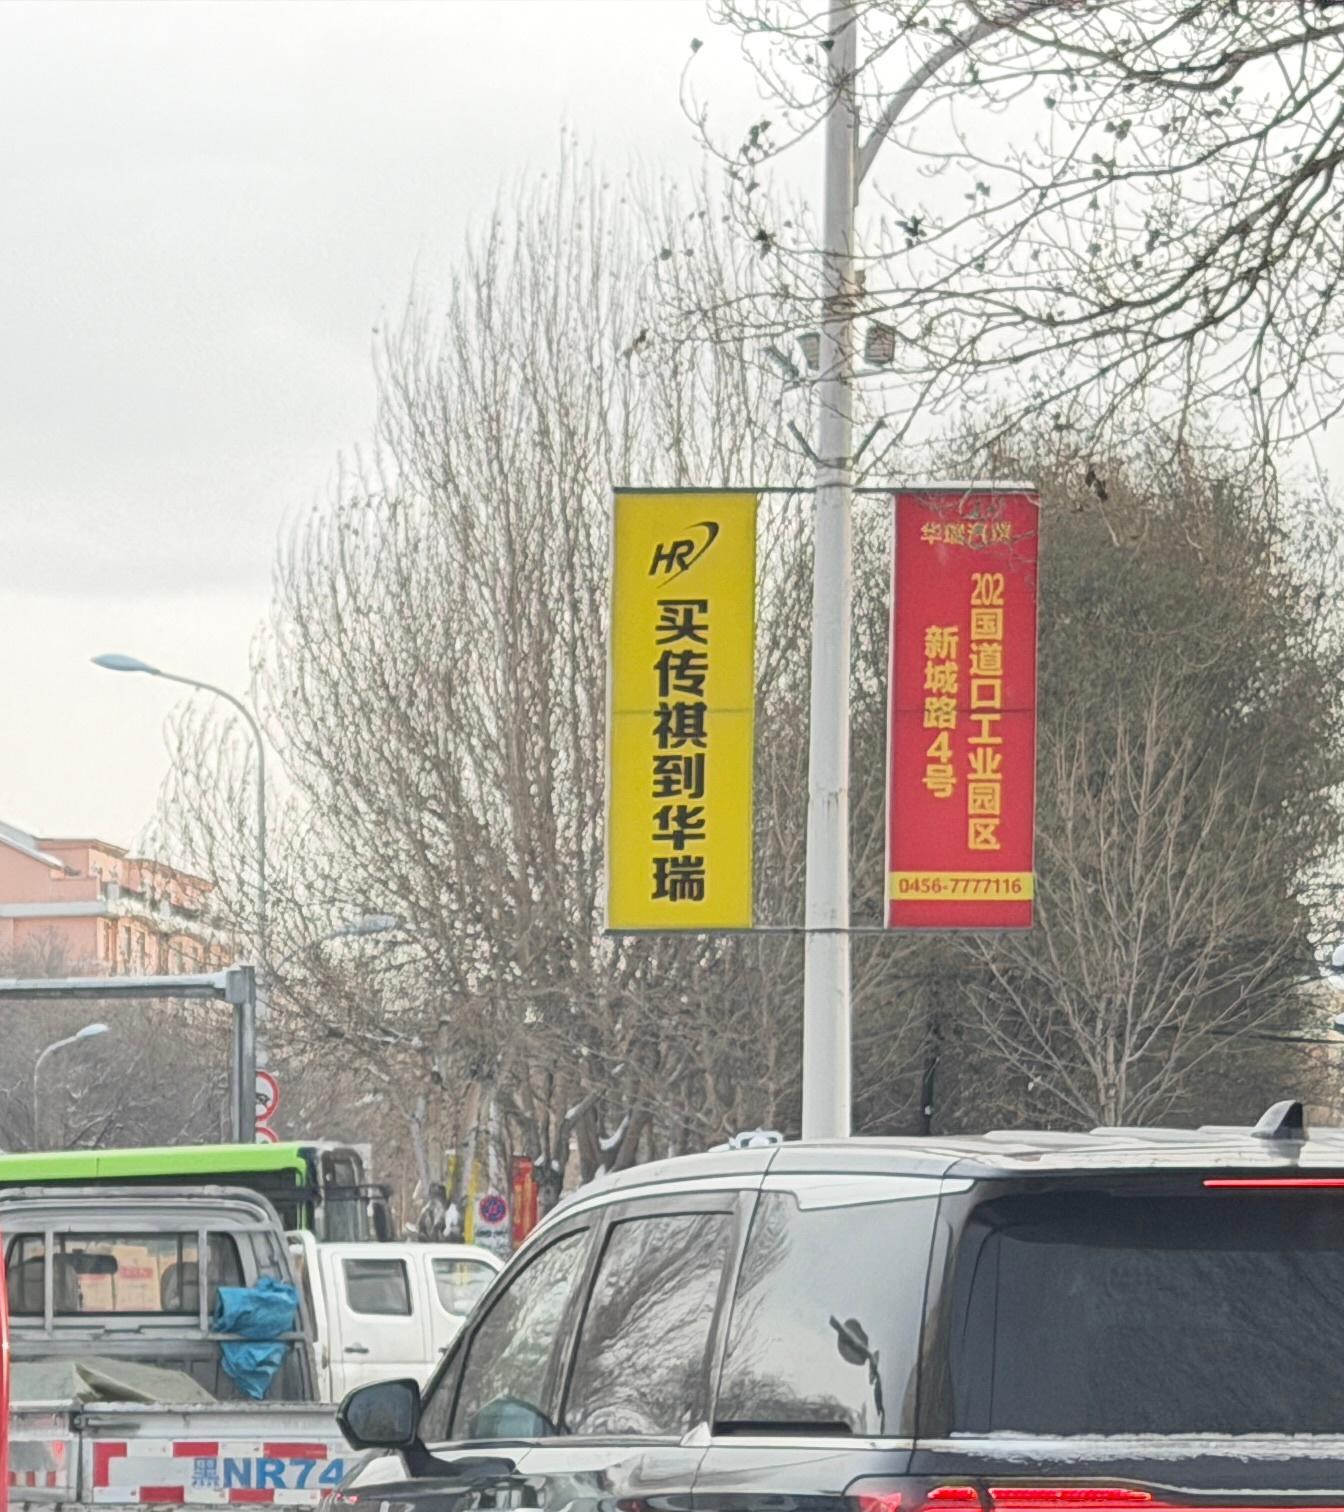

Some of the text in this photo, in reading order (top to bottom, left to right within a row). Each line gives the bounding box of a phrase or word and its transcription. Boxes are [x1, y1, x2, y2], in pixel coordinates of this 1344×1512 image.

[650, 598, 709, 902] 买传祺到华瑞
[922, 625, 958, 799] 新城路4号
[967, 572, 1004, 851] 202国道口工业园区
[898, 878, 1022, 894] 0456-7777116
